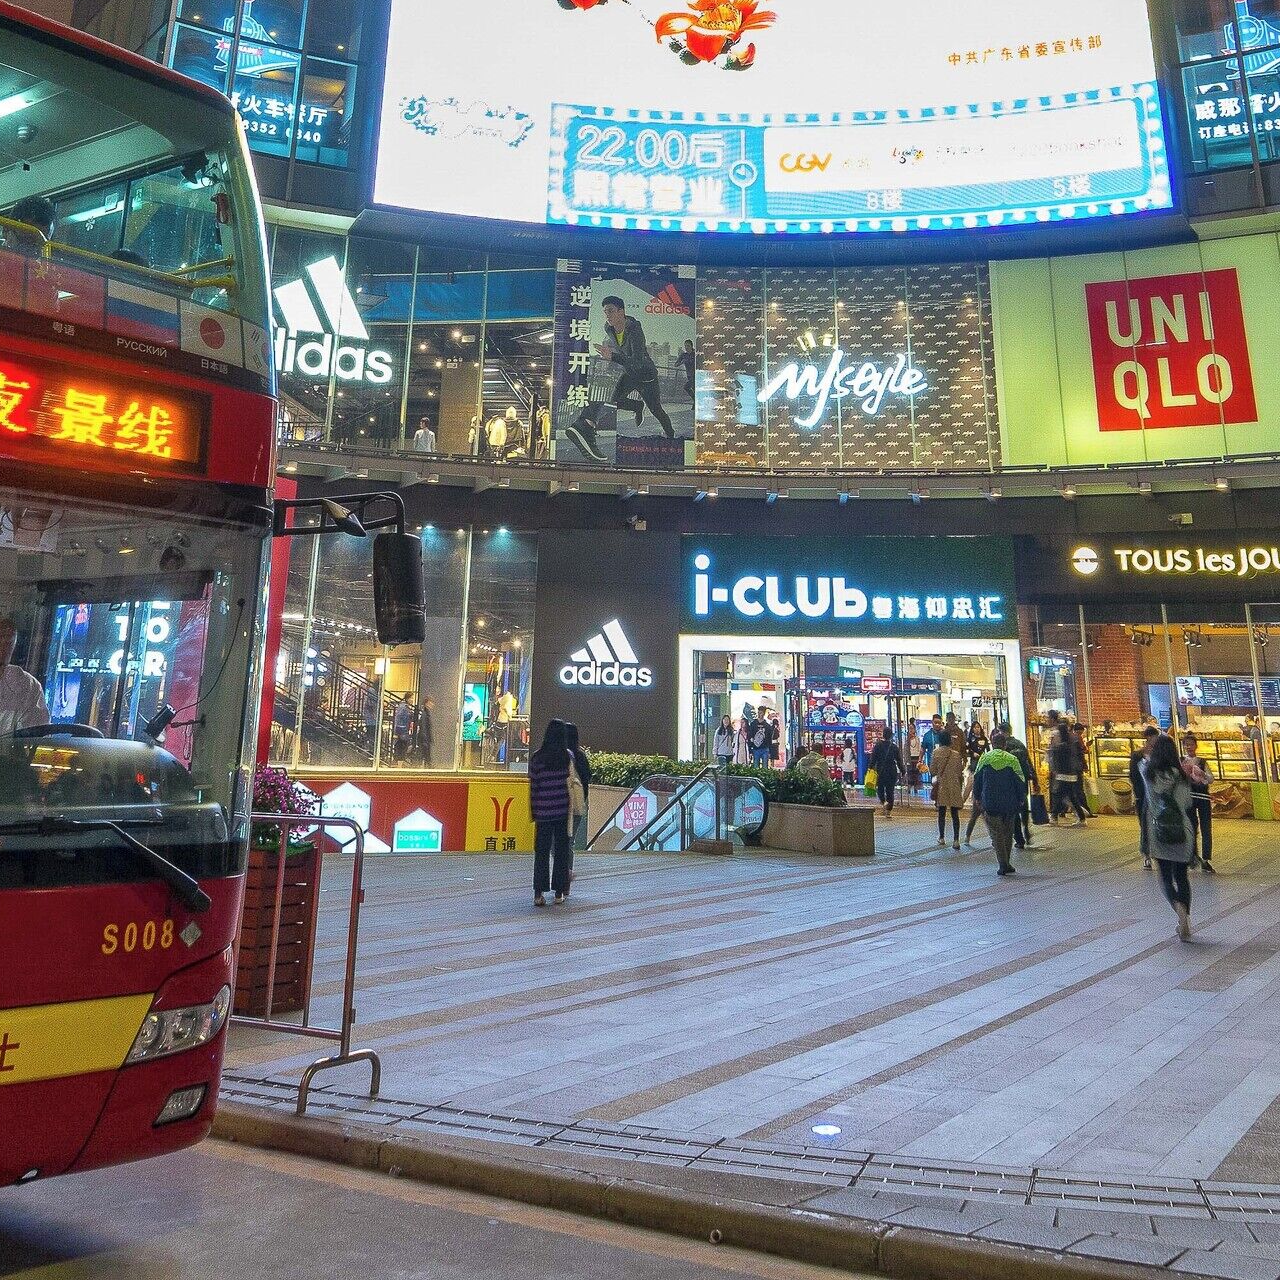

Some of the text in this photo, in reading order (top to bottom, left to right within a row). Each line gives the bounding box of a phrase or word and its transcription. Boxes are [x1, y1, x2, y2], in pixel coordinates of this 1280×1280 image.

[947, 34, 1103, 66] 中共广东省委宣传部
[576, 124, 725, 169] 22:00后
[778, 152, 833, 174] CGV
[644, 304, 690, 316] adidas
[1105, 290, 1215, 349] UNI
[52, 321, 76, 337] 粤语
[116, 337, 168, 359] РУССКИЙ
[567, 285, 593, 408] 逆境开练
[1112, 353, 1235, 419] QLO
[1114, 549, 1192, 572] TOUS
[1199, 548, 1235, 572] les
[559, 660, 652, 687] adidas
[484, 836, 517, 852] 直通
[101, 919, 176, 956] S008
